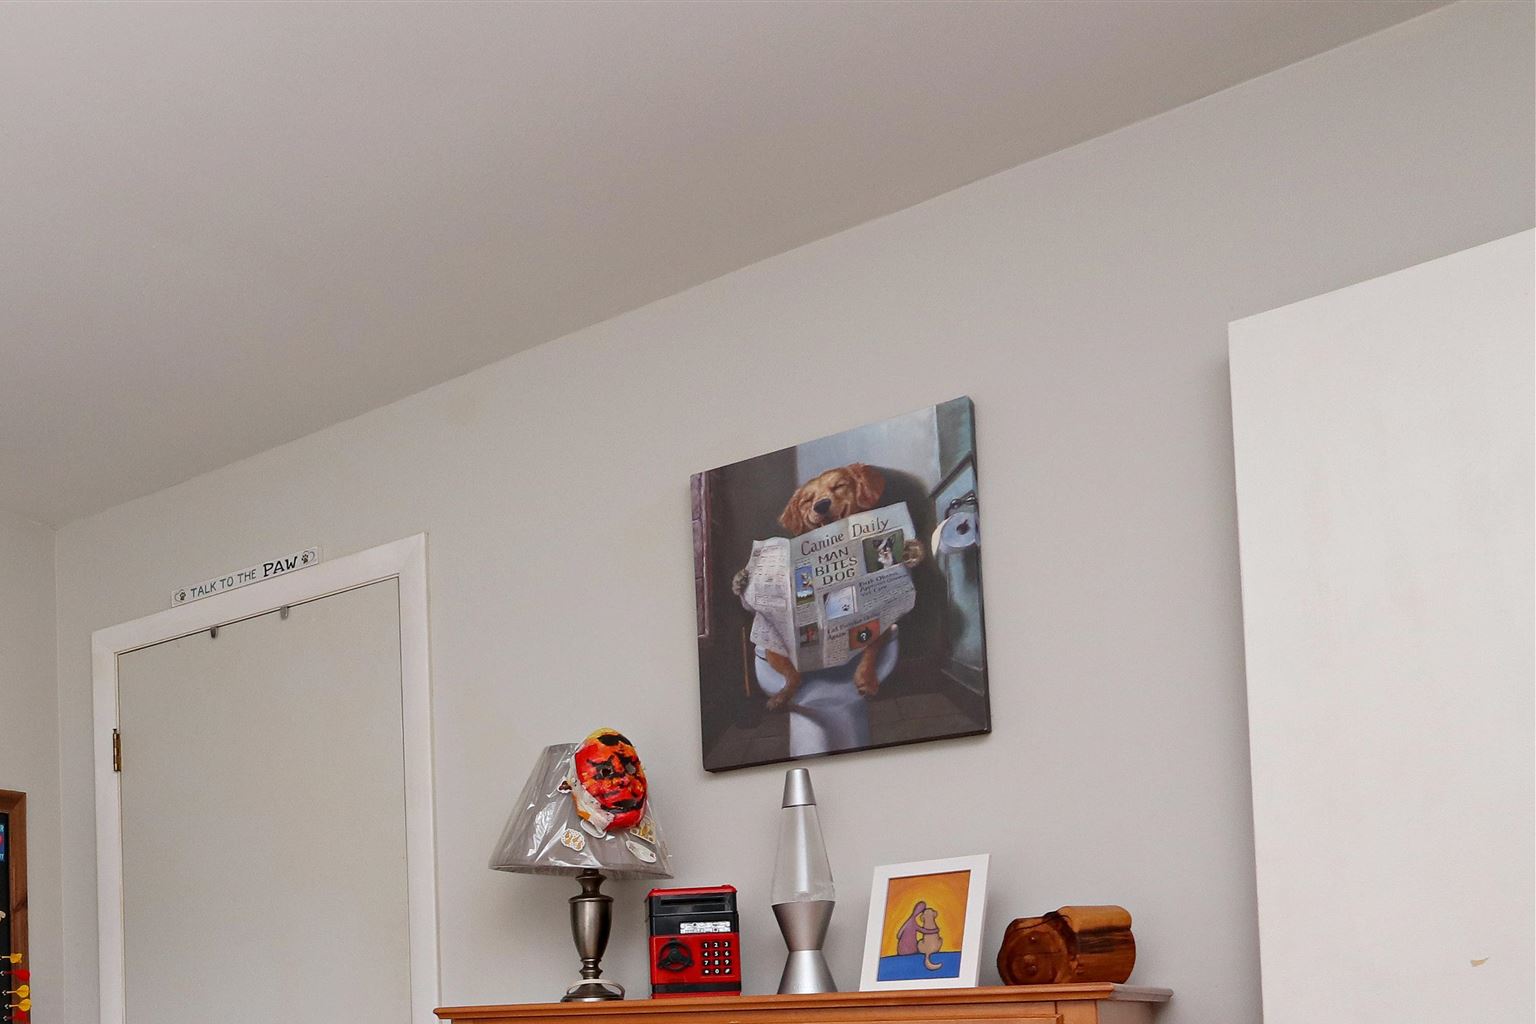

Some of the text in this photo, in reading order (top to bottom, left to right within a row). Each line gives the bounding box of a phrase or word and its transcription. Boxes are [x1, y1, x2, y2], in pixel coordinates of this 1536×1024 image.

[800, 516, 889, 556] Canine Daily
[815, 555, 858, 577] BITES
[818, 546, 849, 564] MAN
[190, 556, 298, 599] TALK TO THE PAW
[822, 568, 855, 586] DOG
